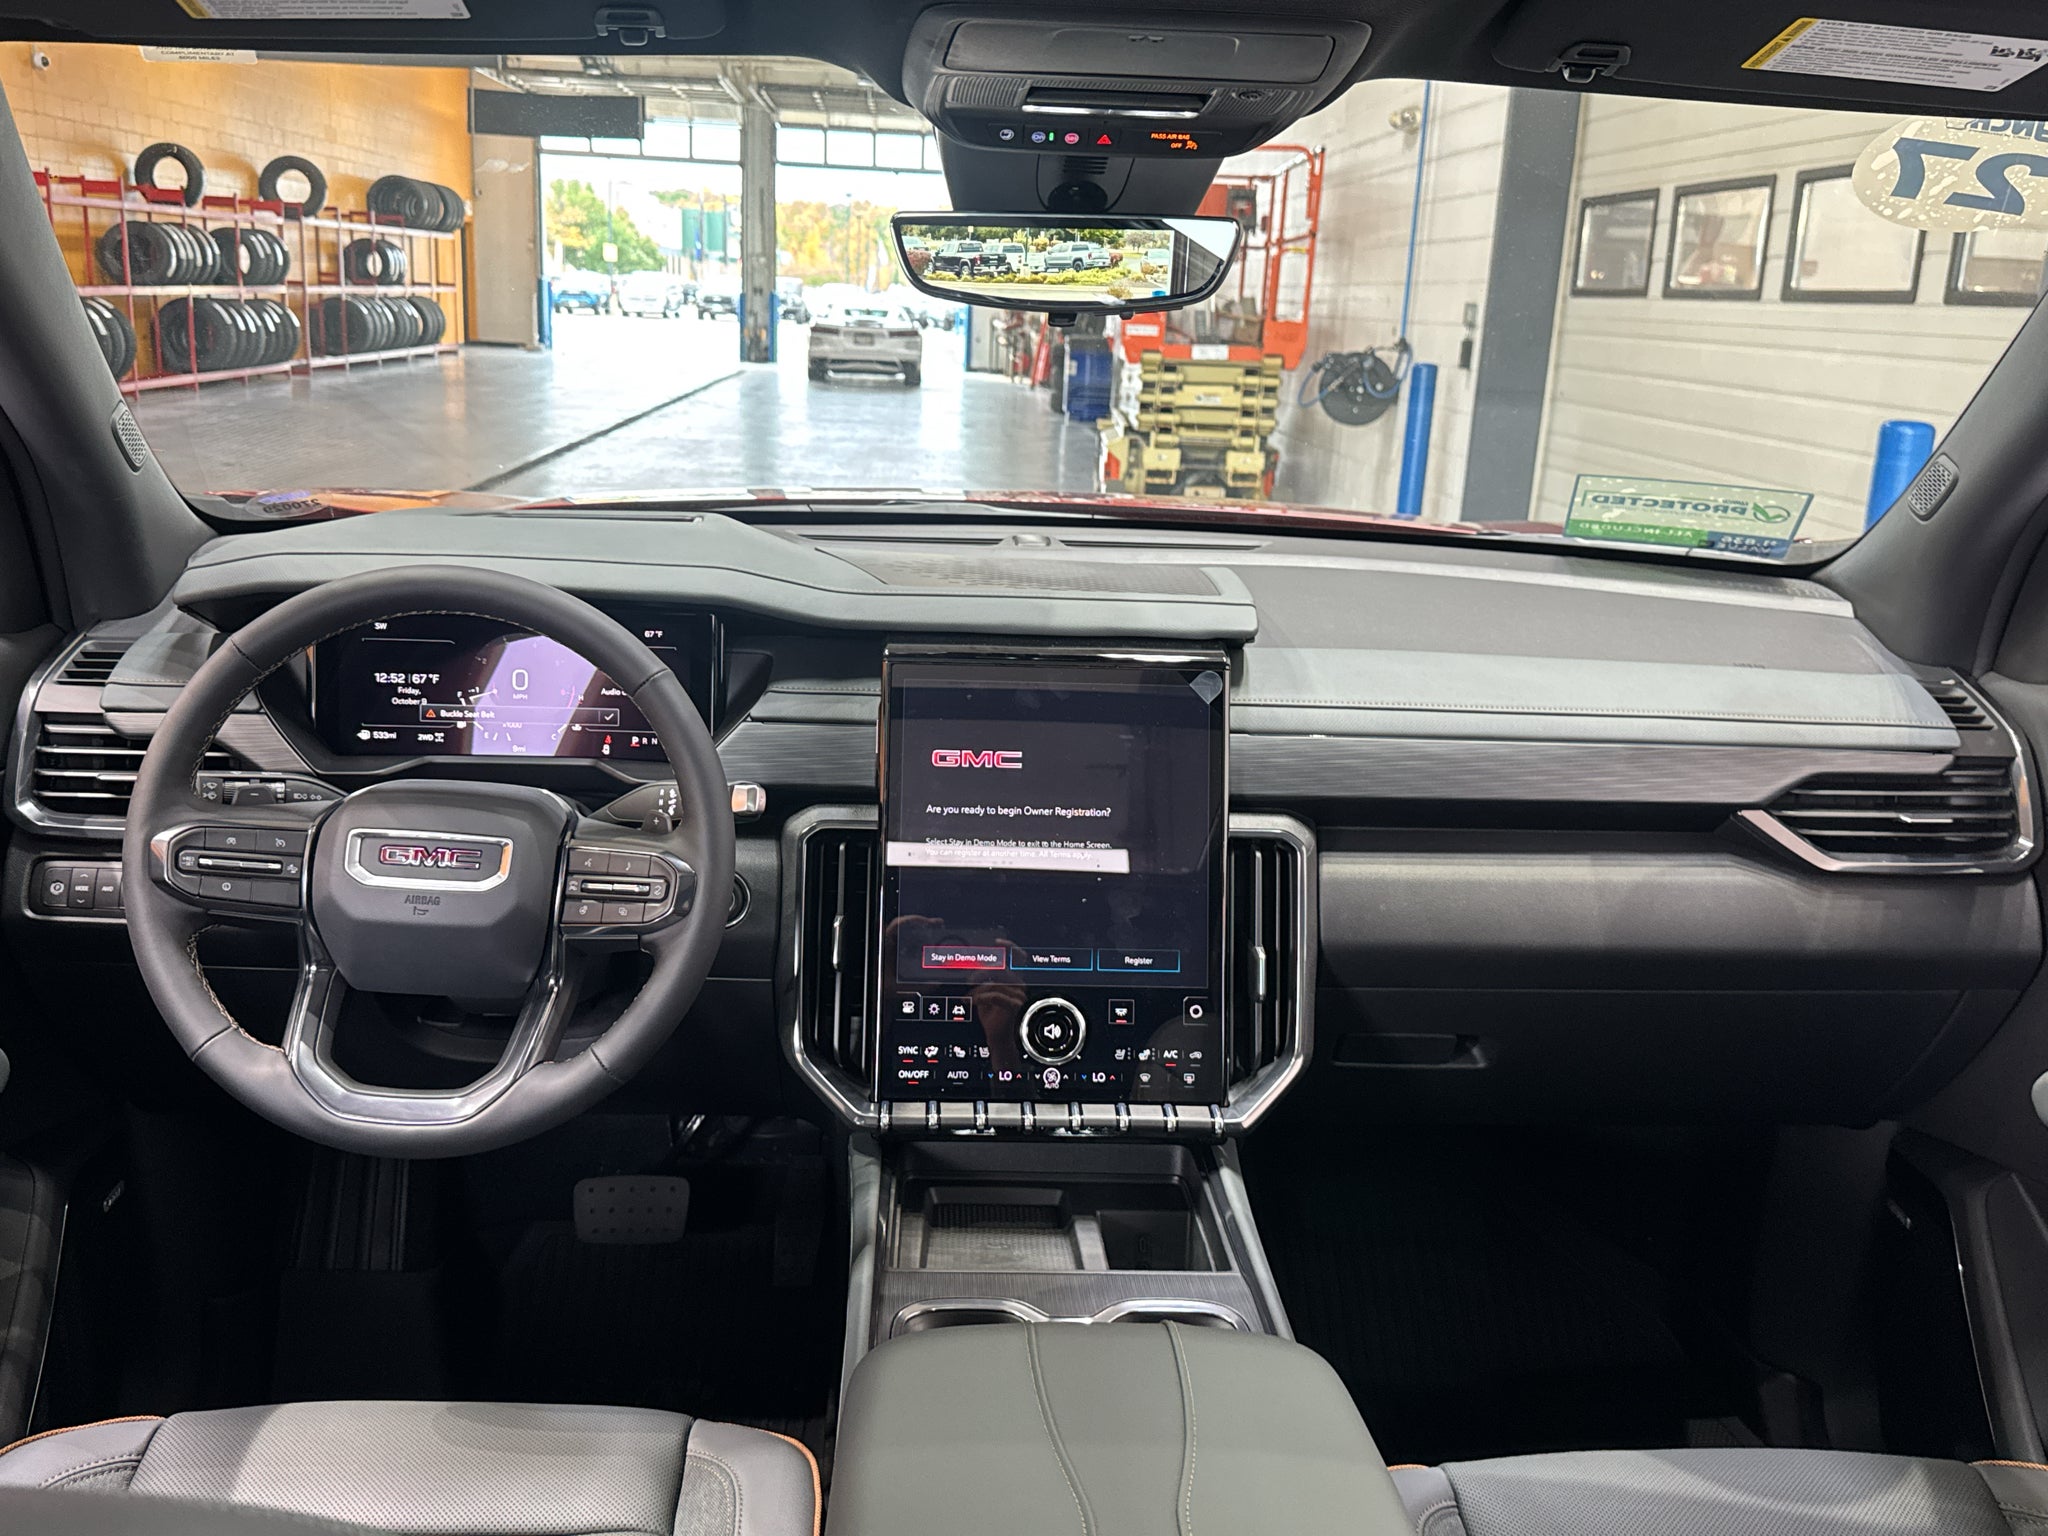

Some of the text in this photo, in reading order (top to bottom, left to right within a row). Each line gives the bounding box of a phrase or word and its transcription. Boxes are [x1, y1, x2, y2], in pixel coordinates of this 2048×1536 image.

[374, 622, 388, 630] SW
[374, 673, 406, 683] 12:52
[512, 669, 529, 690] 0
[601, 688, 621, 696] Audio
[391, 697, 420, 705] October
[440, 709, 496, 718] Buckle Seat Belt
[631, 736, 640, 744] P
[931, 749, 1023, 769] GMC
[926, 804, 1112, 819] Are you ready to begin Owner Registration?
[925, 838, 948, 846] Select
[948, 838, 964, 848] Stay
[965, 838, 972, 846] in
[973, 839, 995, 847] Demo
[996, 839, 1017, 847] Mode
[1041, 840, 1049, 848] to
[1050, 840, 1062, 848] the
[1086, 841, 1113, 850] Screen.
[380, 844, 482, 869] GMC
[990, 849, 1018, 857] another
[404, 895, 441, 906] AIRBAG
[931, 953, 947, 963] Stay
[977, 954, 998, 962] Mode
[1032, 955, 1049, 963] View
[1124, 957, 1153, 966] Register
[898, 1046, 919, 1055] SYNC
[1163, 1050, 1179, 1059] A/C
[898, 1070, 930, 1079] ON/OFF
[947, 1071, 969, 1079] AUTO
[999, 1071, 1013, 1081] LO
[1092, 1072, 1106, 1083] LO
